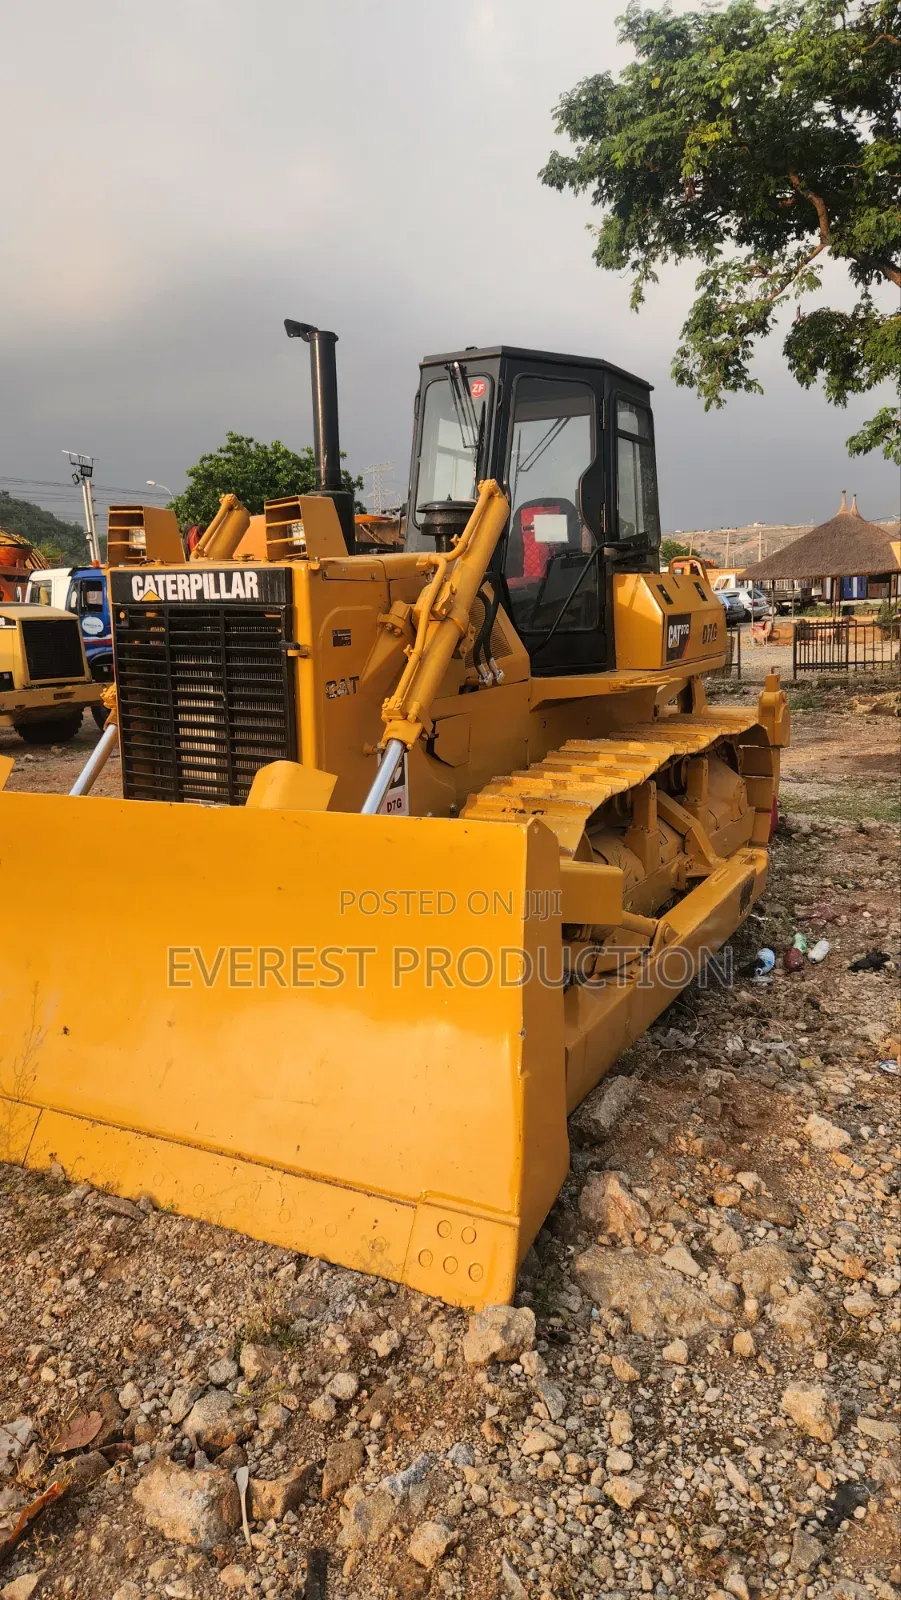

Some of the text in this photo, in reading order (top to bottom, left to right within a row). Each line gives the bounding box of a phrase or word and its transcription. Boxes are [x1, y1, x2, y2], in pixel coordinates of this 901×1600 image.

[472, 383, 485, 393] ZF
[131, 571, 259, 601] CATERPILLAR
[668, 624, 681, 649] CAT
[702, 622, 718, 645] D7G
[325, 676, 359, 700] CAT
